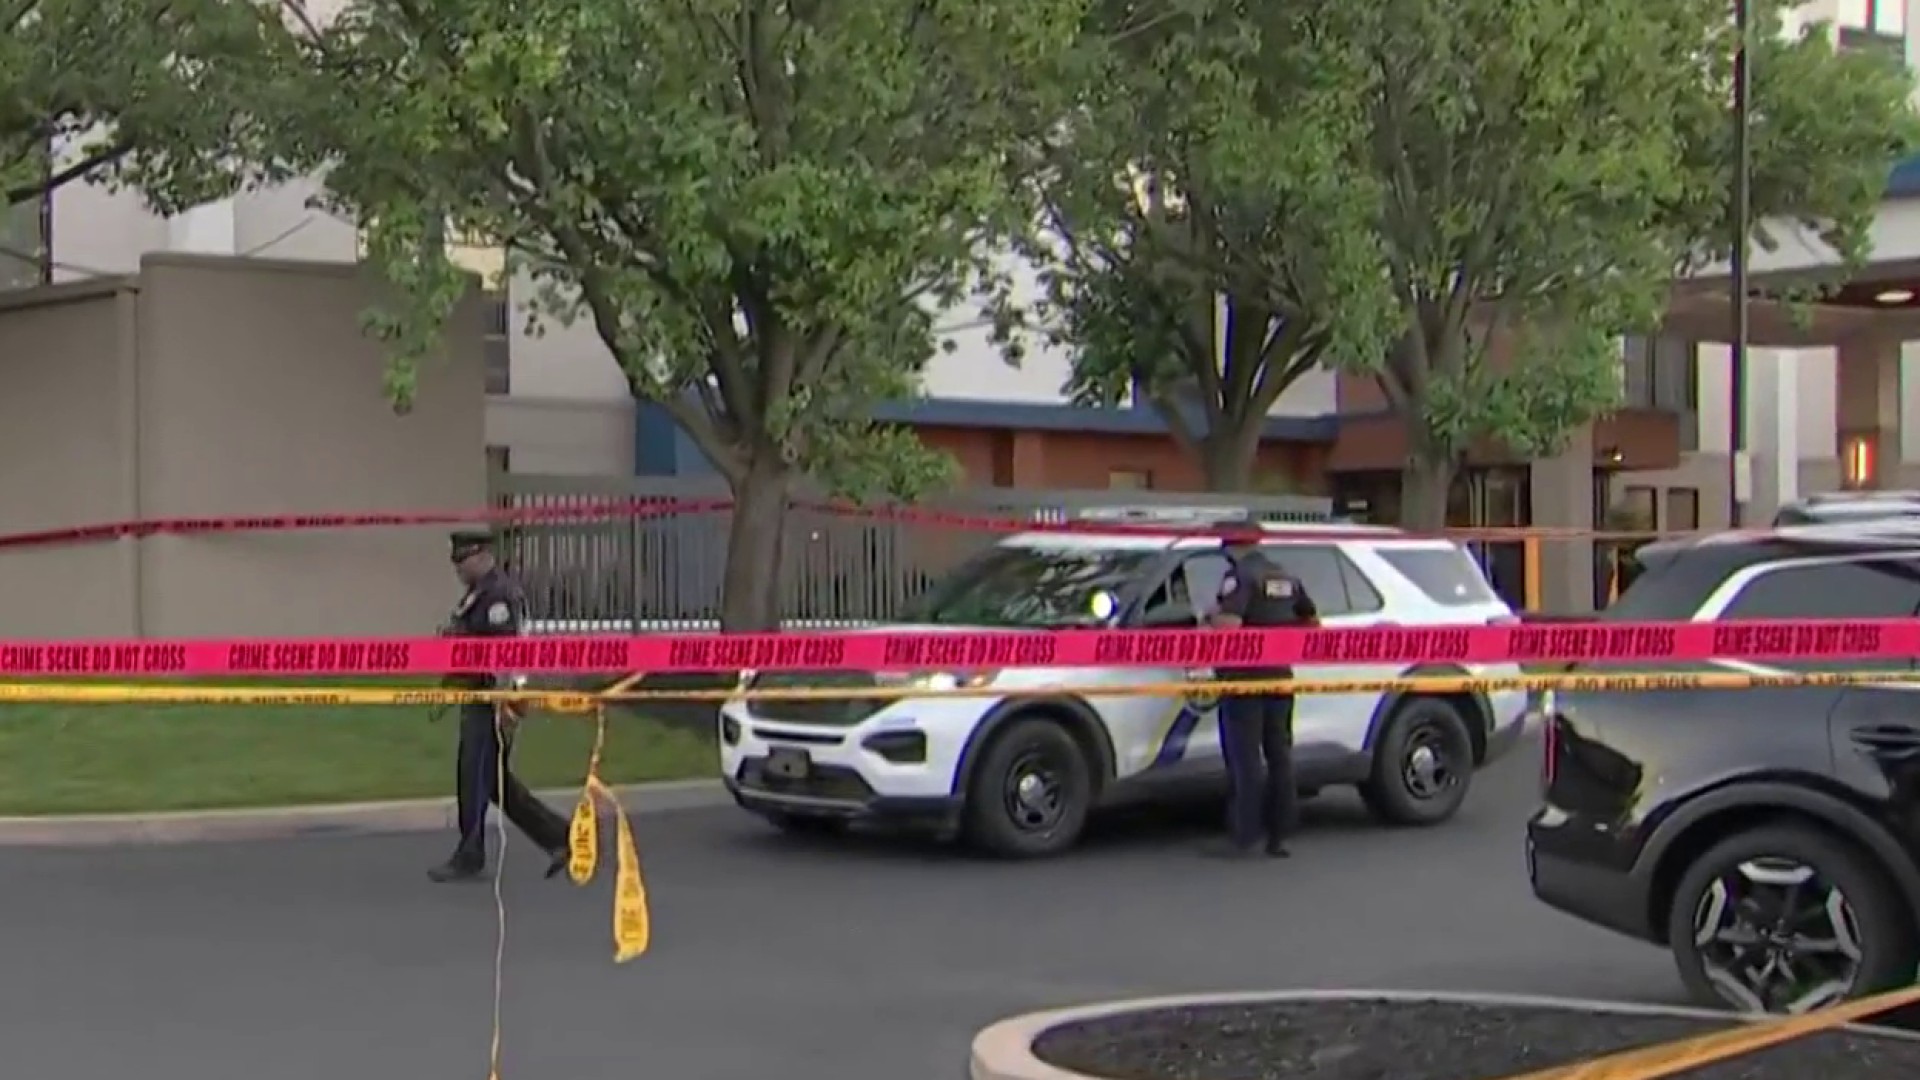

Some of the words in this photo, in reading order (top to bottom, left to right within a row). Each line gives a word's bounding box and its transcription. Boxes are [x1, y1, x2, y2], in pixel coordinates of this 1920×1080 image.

[670, 640, 710, 666] CRIME
[713, 639, 753, 666] SCENE
[755, 639, 774, 665] DO
[775, 639, 802, 665] NOT
[803, 638, 844, 665] CROSS
[884, 637, 924, 665] CRIME
[926, 636, 966, 665] SCENE
[968, 636, 987, 664] DO
[988, 636, 1014, 664] NOT
[1014, 635, 1056, 664] CROSS
[1095, 634, 1134, 662] CRIME
[1136, 634, 1176, 662] SCENE
[1177, 634, 1196, 662] DO
[1197, 634, 1223, 662] NOT
[1224, 633, 1265, 661] CROSS
[1302, 631, 1342, 659] CRIME
[1343, 631, 1383, 660] SCENE
[1384, 631, 1403, 659] DO
[1404, 630, 1429, 659] NOT
[1429, 629, 1470, 659] CROSS
[1508, 629, 1548, 657] CRIME
[1549, 629, 1588, 657] SCENE
[1590, 628, 1608, 657] DO
[1608, 628, 1634, 656] NOT
[1635, 627, 1676, 656] CROSS
[1712, 626, 1752, 655] CRIME
[1754, 626, 1793, 654] SCENE
[1794, 626, 1813, 654] DO
[1814, 625, 1841, 654] NOT
[1842, 624, 1881, 653] CROSS
[1, 646, 43, 672] CRIME
[47, 646, 90, 672] SCENE
[92, 646, 111, 671] DO
[114, 646, 140, 671] NOT
[143, 645, 186, 671] CROSS
[229, 644, 271, 670] CRIME
[273, 644, 315, 670] SCENE
[317, 643, 336, 669] DO
[339, 643, 365, 669] NOT
[367, 643, 409, 669] CROSS
[451, 643, 491, 668] CRIME
[495, 642, 537, 668] SCENE
[538, 641, 556, 668] DO
[559, 641, 585, 667] NOT
[587, 641, 628, 667] CROSS
